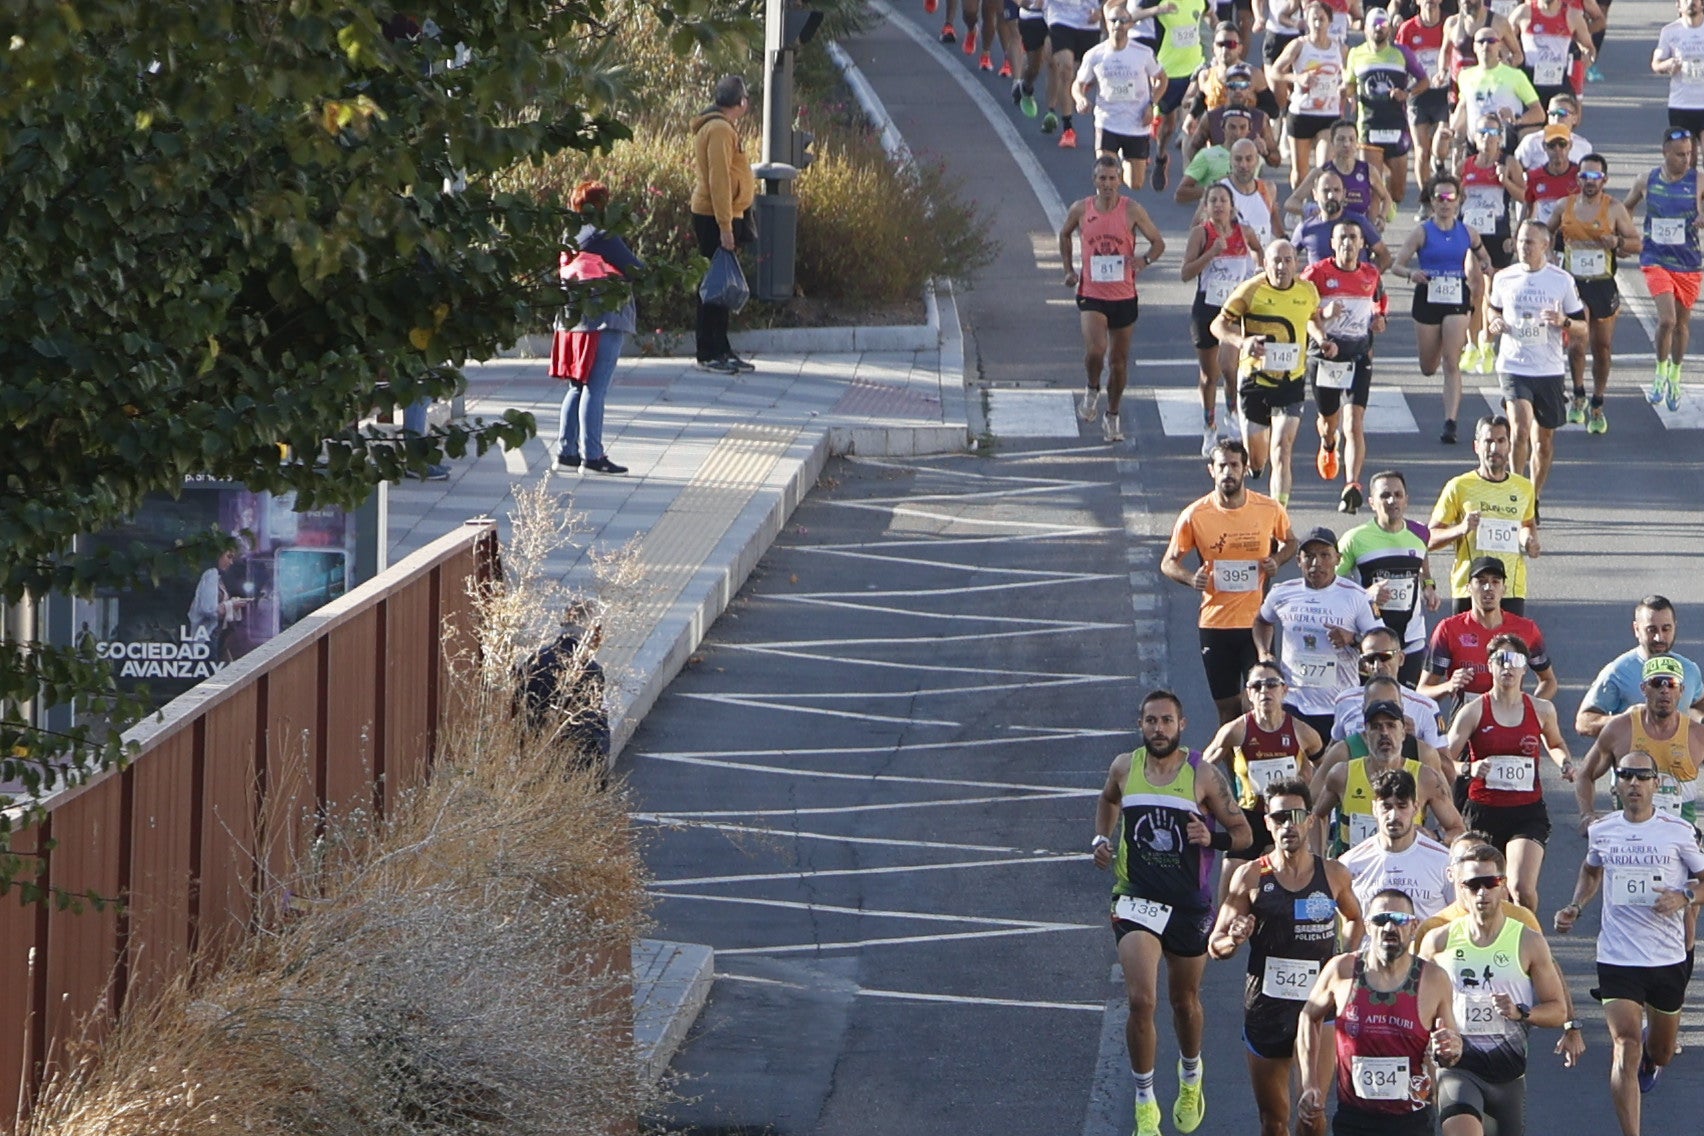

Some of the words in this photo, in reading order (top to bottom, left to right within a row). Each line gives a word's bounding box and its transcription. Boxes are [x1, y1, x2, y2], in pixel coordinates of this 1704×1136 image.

[1471, 217, 1484, 226] 43
[1658, 226, 1678, 236] 257
[1101, 264, 1113, 273] 81
[1580, 258, 1594, 267] 54
[1435, 283, 1456, 294] 482
[1517, 327, 1540, 338] 368
[1272, 351, 1292, 362] 148
[1488, 528, 1511, 542] 150
[1223, 569, 1249, 582] 395
[1390, 588, 1407, 600] 36
[180, 624, 211, 642] LA
[96, 641, 210, 660] SOCIEDAD
[1300, 663, 1327, 677] 377
[1497, 766, 1525, 780] 180
[1620, 845, 1658, 854] CARRERA
[1643, 855, 1671, 865] CIVIL
[1627, 879, 1646, 894] 61
[1130, 902, 1158, 918] 138
[1275, 970, 1308, 987] 542
[1365, 1014, 1387, 1024] APIS
[1388, 1015, 1414, 1029] DURI
[1363, 1070, 1397, 1086] 334
